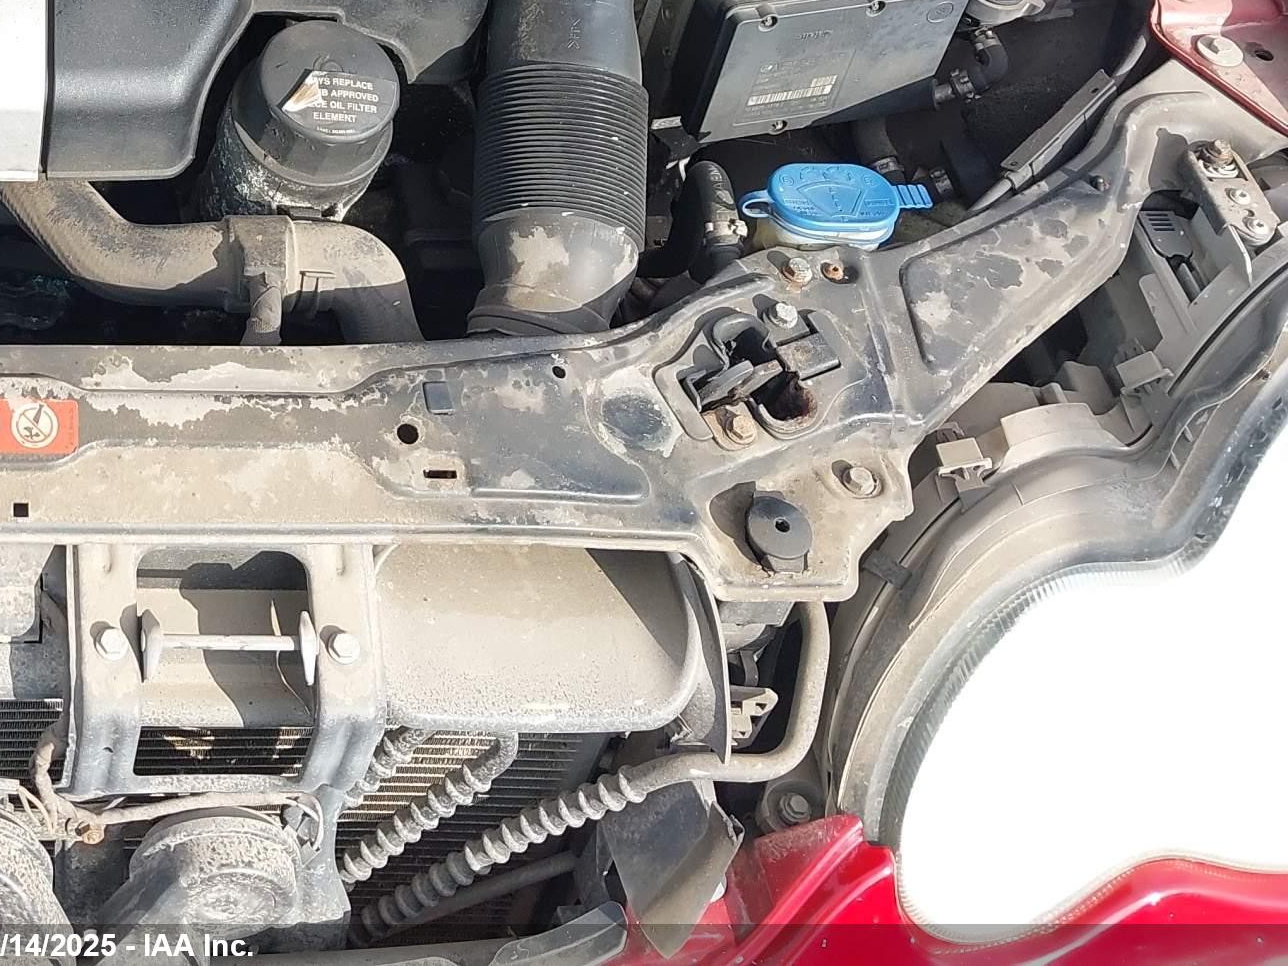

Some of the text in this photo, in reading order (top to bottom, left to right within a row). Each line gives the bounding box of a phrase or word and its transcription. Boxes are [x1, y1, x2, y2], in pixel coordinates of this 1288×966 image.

[332, 78, 373, 90] REPLACE
[330, 89, 379, 102] APPROVED
[329, 101, 345, 110] OIL
[347, 102, 377, 114] FILTER
[313, 112, 357, 123] ELEMENT
